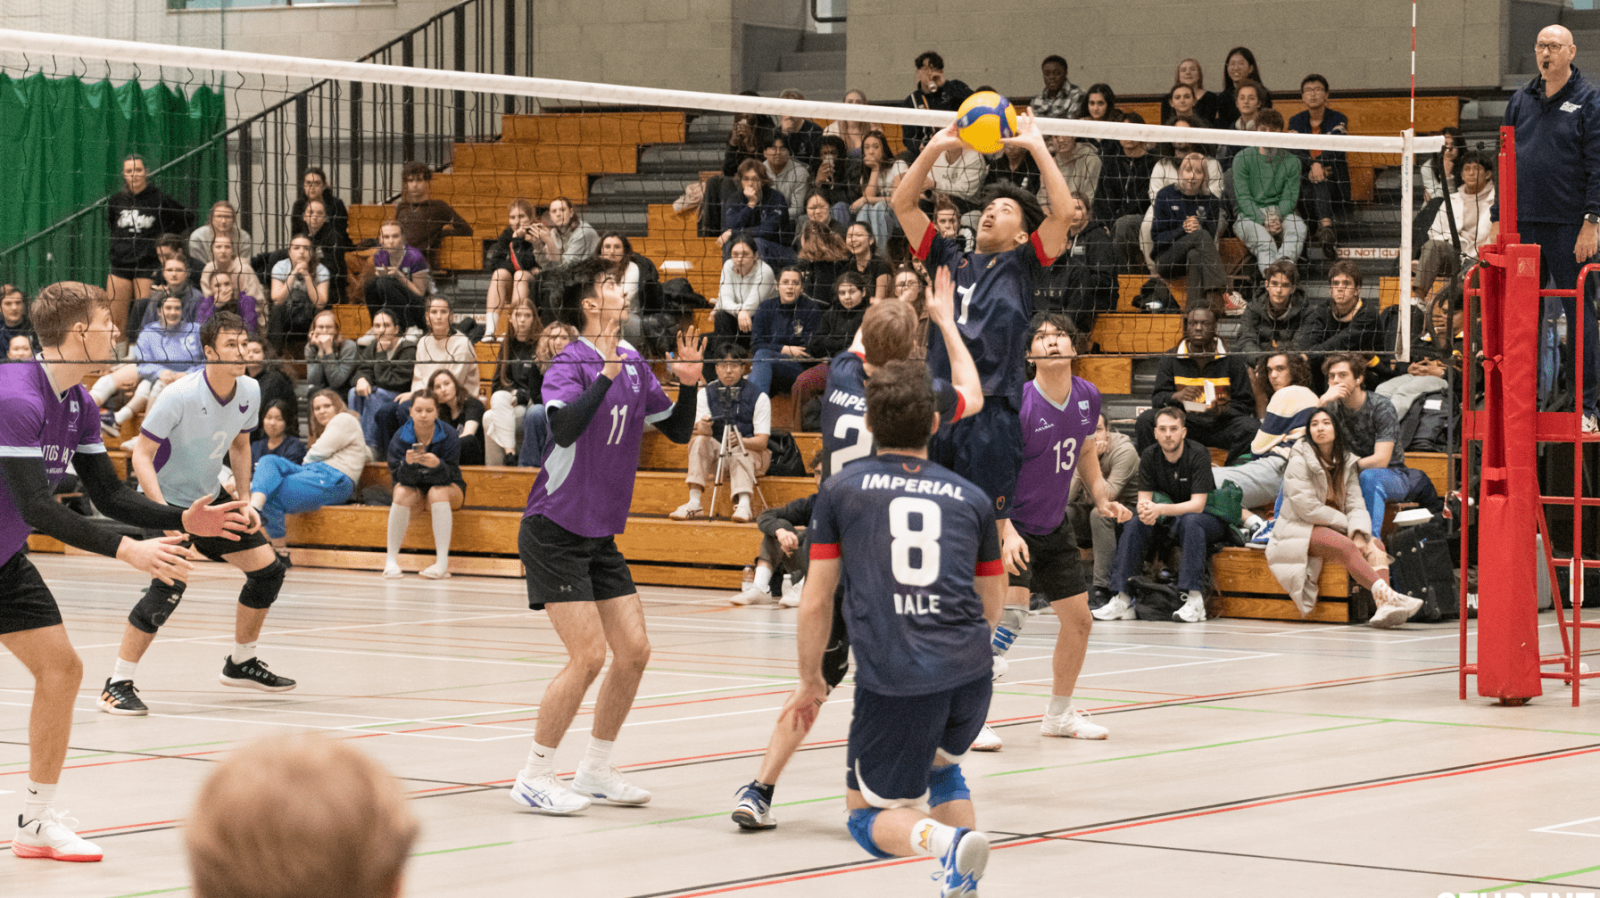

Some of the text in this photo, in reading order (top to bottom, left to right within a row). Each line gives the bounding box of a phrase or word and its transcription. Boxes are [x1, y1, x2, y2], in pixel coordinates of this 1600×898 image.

[828, 388, 868, 411] IMPE
[606, 404, 628, 445] 11
[208, 430, 228, 460] 2
[830, 413, 873, 475] 2
[1053, 437, 1077, 474] 13
[861, 473, 965, 501] IMPERIAL
[889, 496, 942, 587] 8
